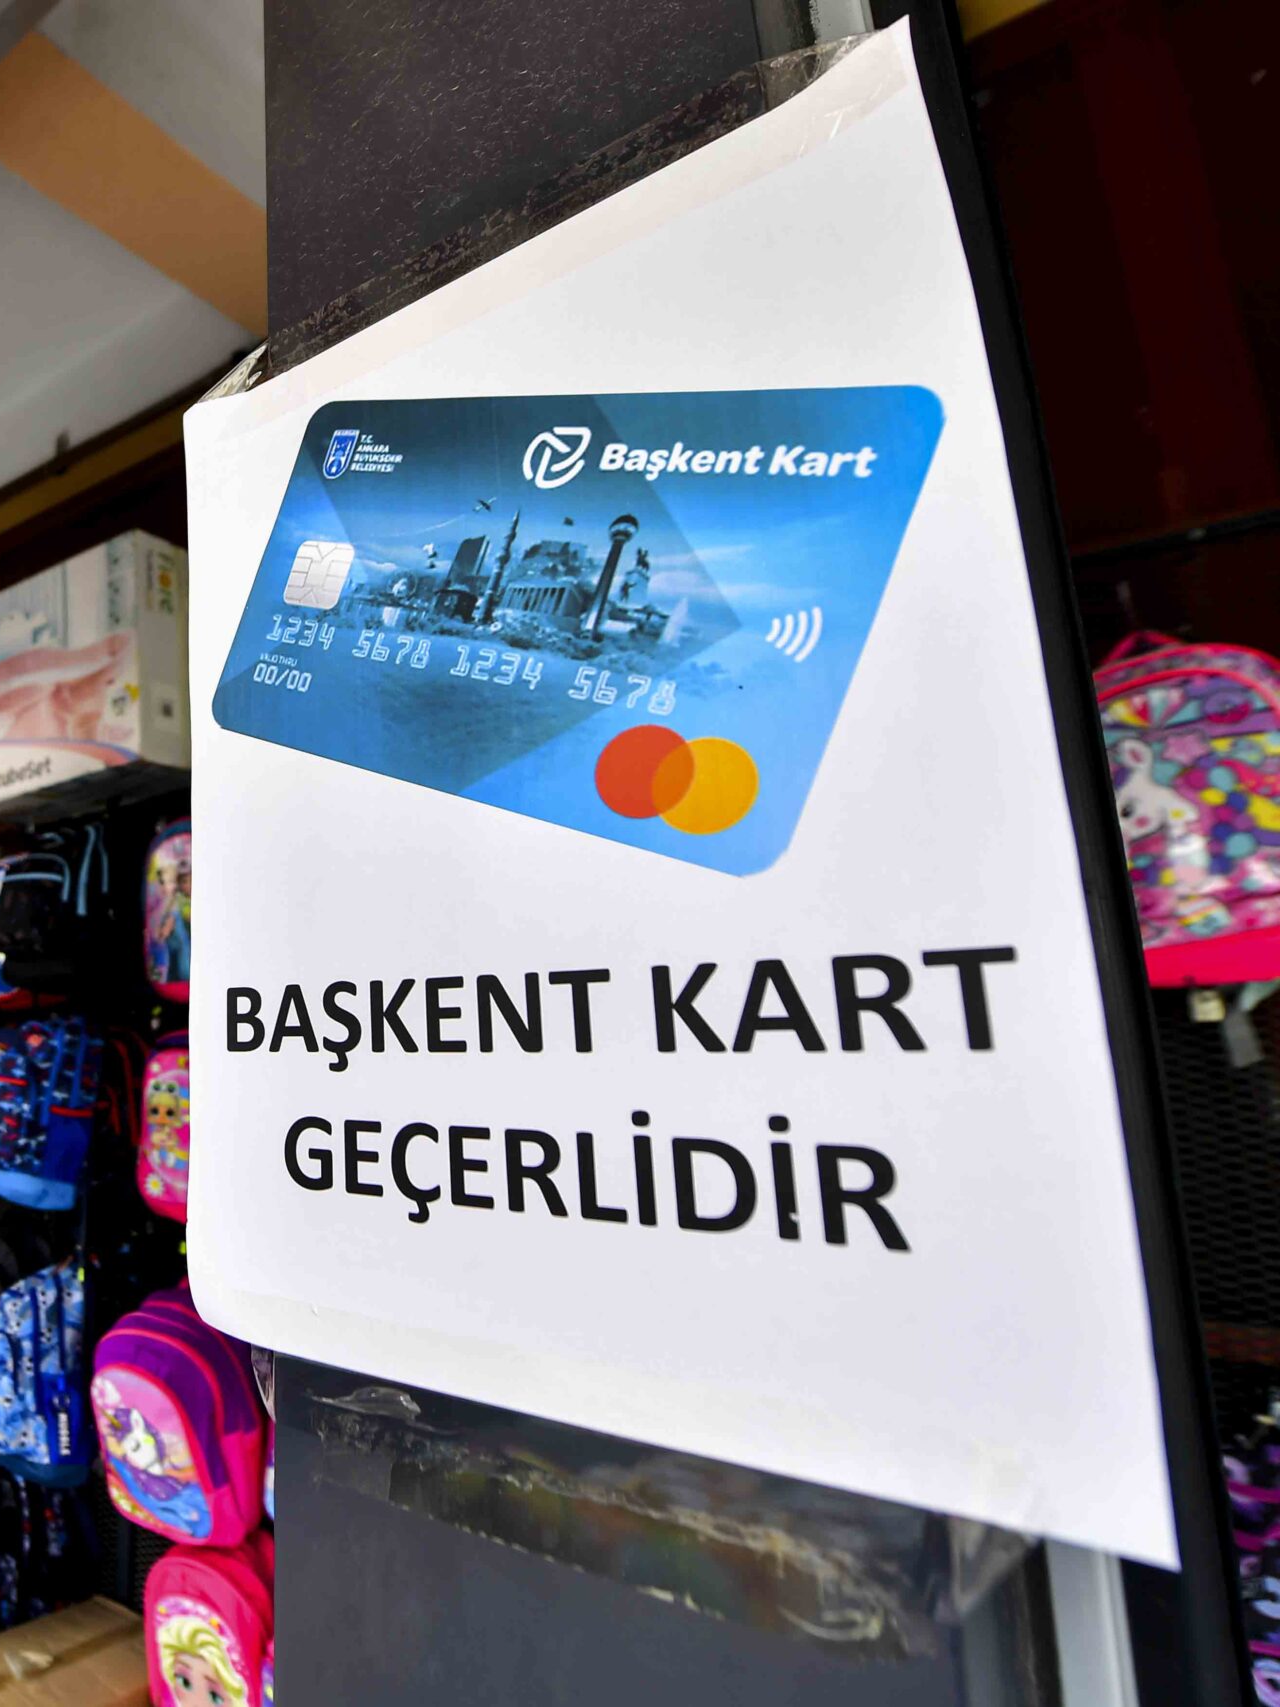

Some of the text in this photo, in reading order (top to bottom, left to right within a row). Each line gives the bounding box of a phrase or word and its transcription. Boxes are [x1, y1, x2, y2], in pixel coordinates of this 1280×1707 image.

[356, 444, 389, 453] ANKARA
[599, 442, 877, 481] Başkent Kart
[253, 663, 312, 693] 00/00
[266, 614, 676, 716] 1234 5678 1234 5678
[226, 946, 1016, 1072] BAŞKENT KART
[283, 1110, 912, 1254] GEÇERLİDİR
